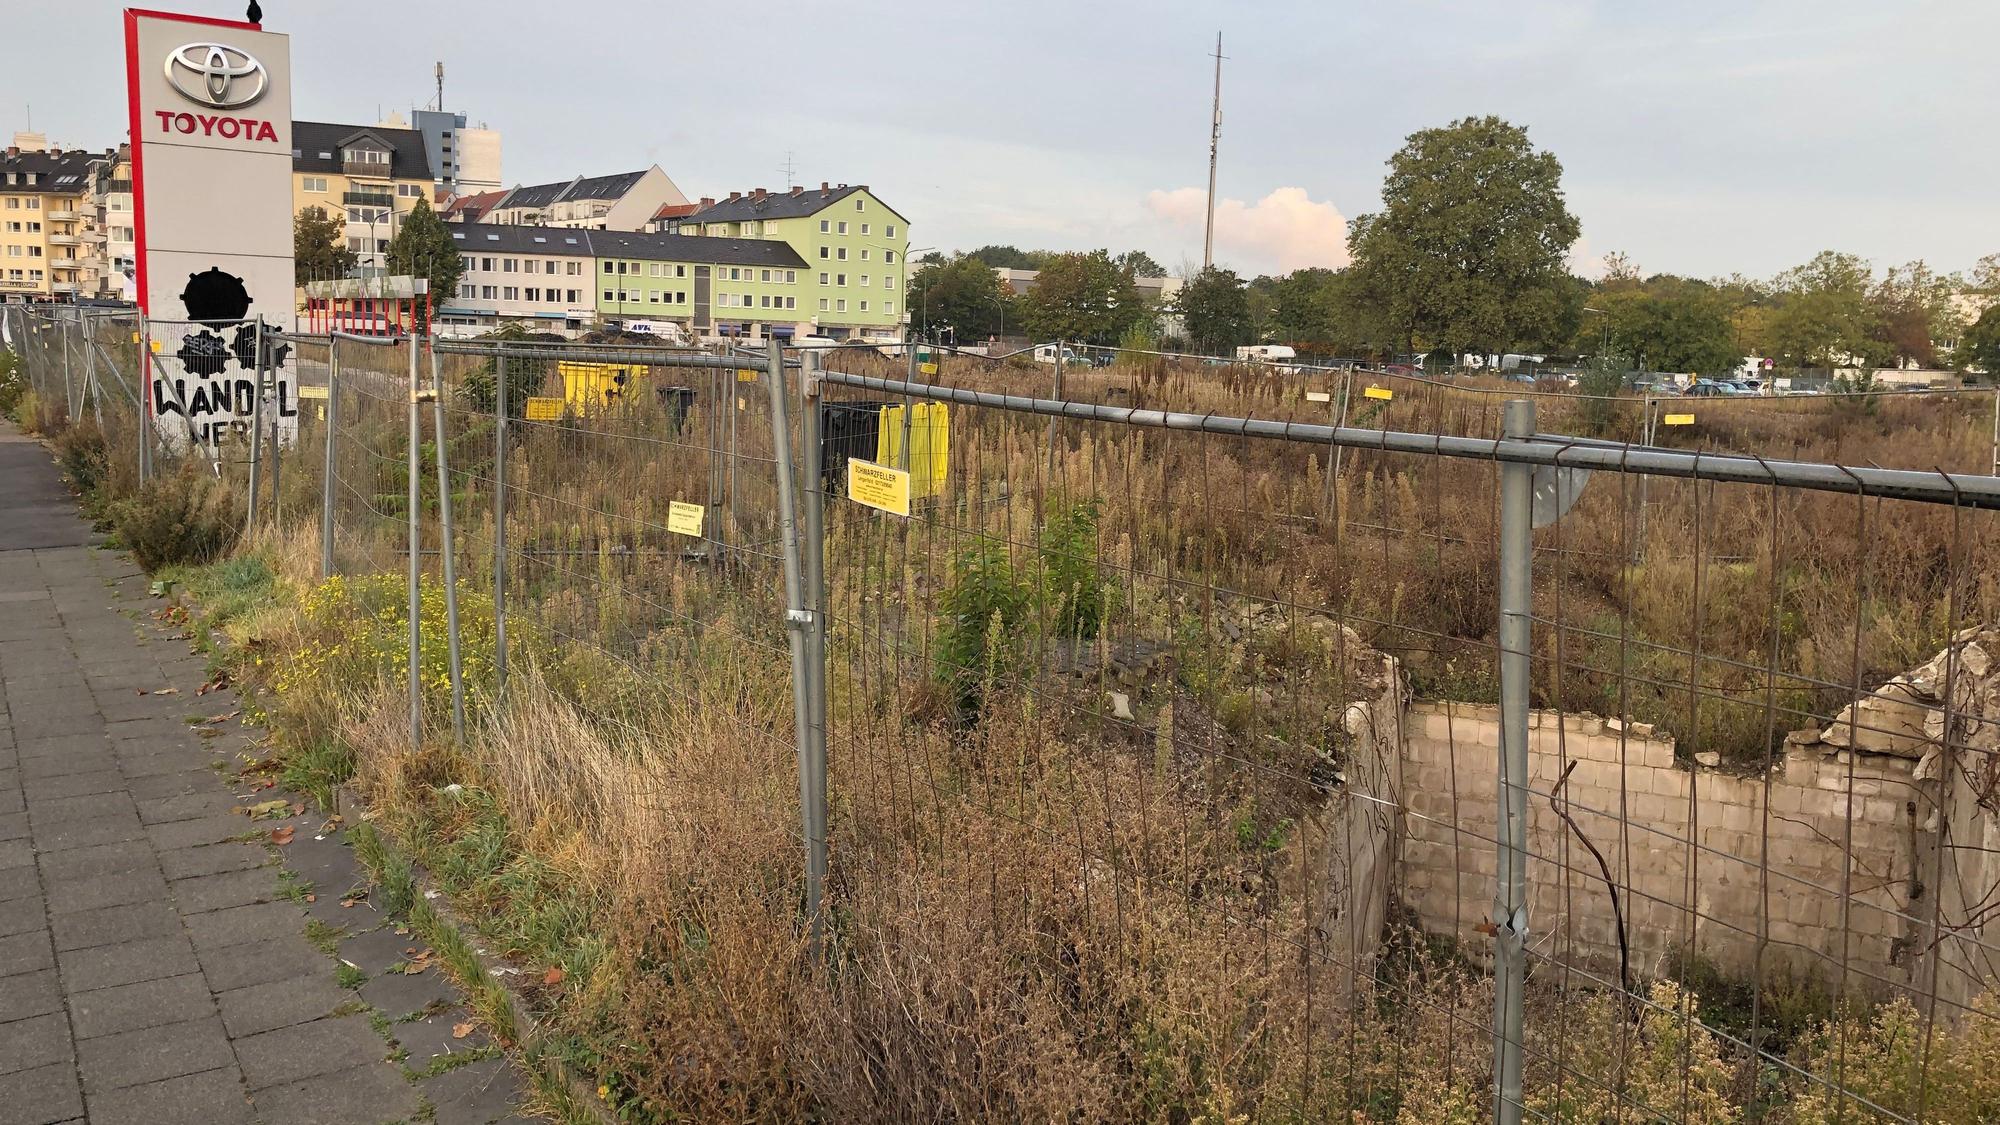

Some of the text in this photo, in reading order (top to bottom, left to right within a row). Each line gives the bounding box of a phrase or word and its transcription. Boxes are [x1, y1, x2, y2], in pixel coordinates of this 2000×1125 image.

[156, 111, 278, 142] TOYOTA
[153, 379, 298, 417] WANDL
[190, 421, 253, 448] WER
[855, 465, 897, 482] SCHWARZFELLER
